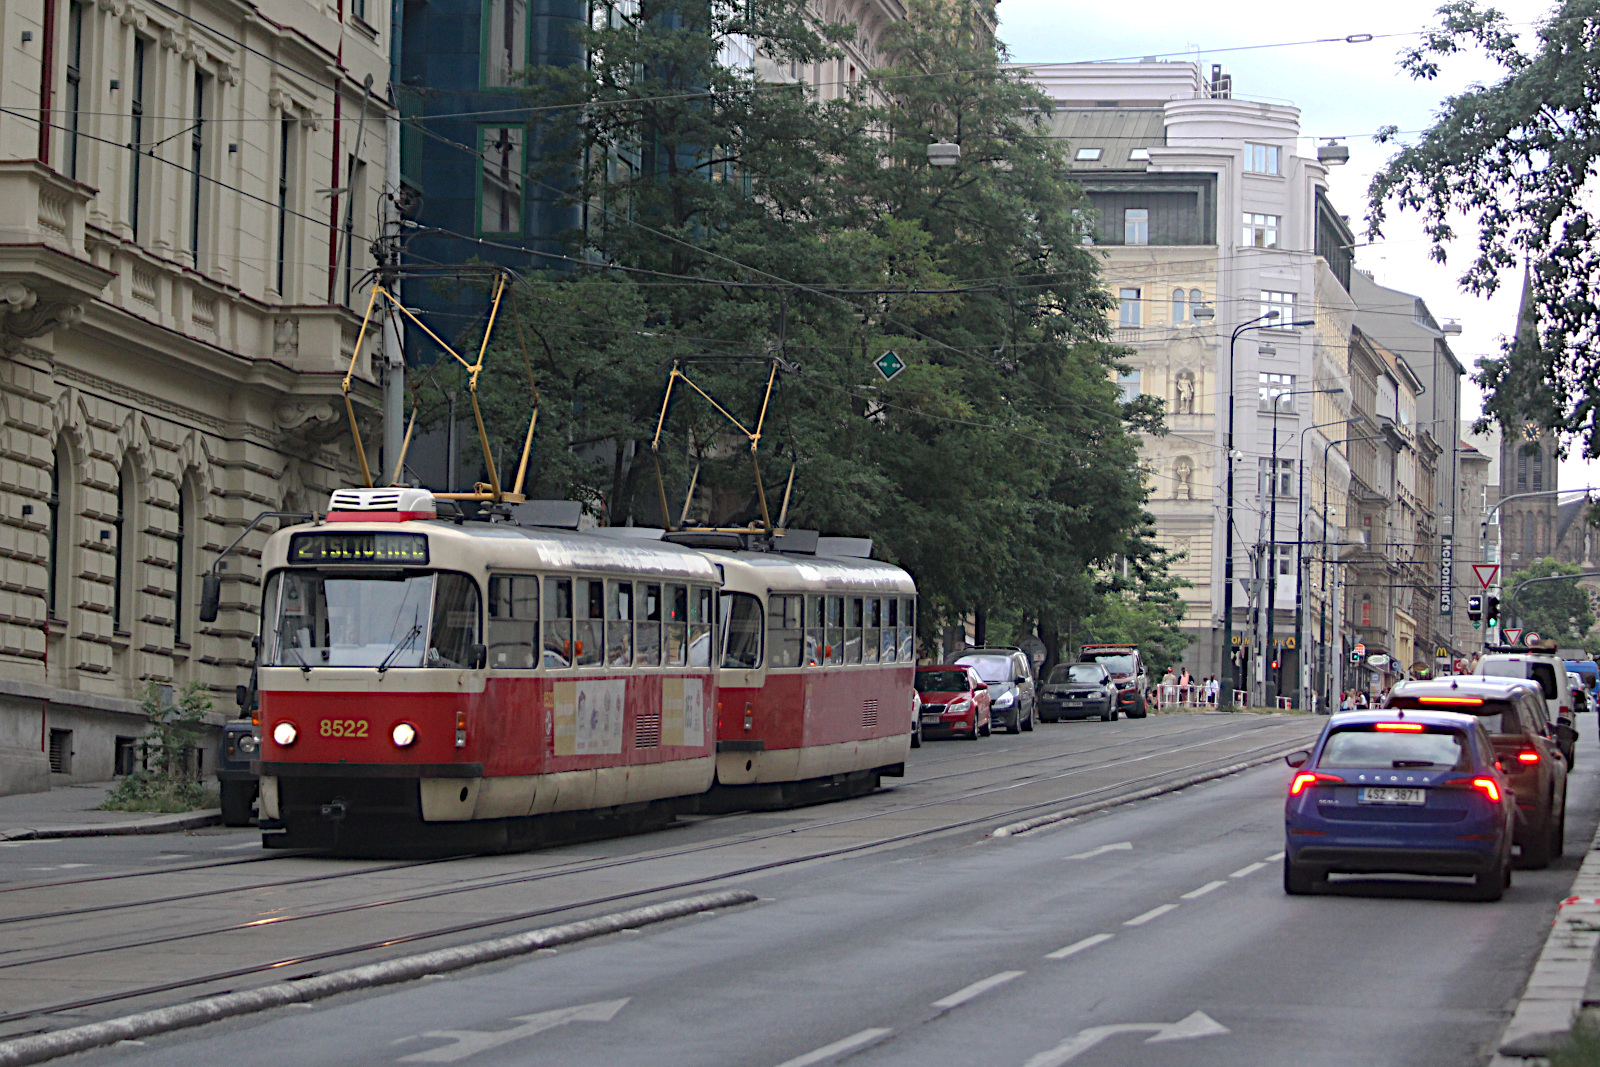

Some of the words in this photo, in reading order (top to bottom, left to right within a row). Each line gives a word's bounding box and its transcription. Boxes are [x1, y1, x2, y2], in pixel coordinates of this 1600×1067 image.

[299, 535, 326, 558] 21
[320, 719, 368, 737] 8522
[1367, 788, 1386, 800] 4SZ
[1394, 789, 1419, 800] 3871
